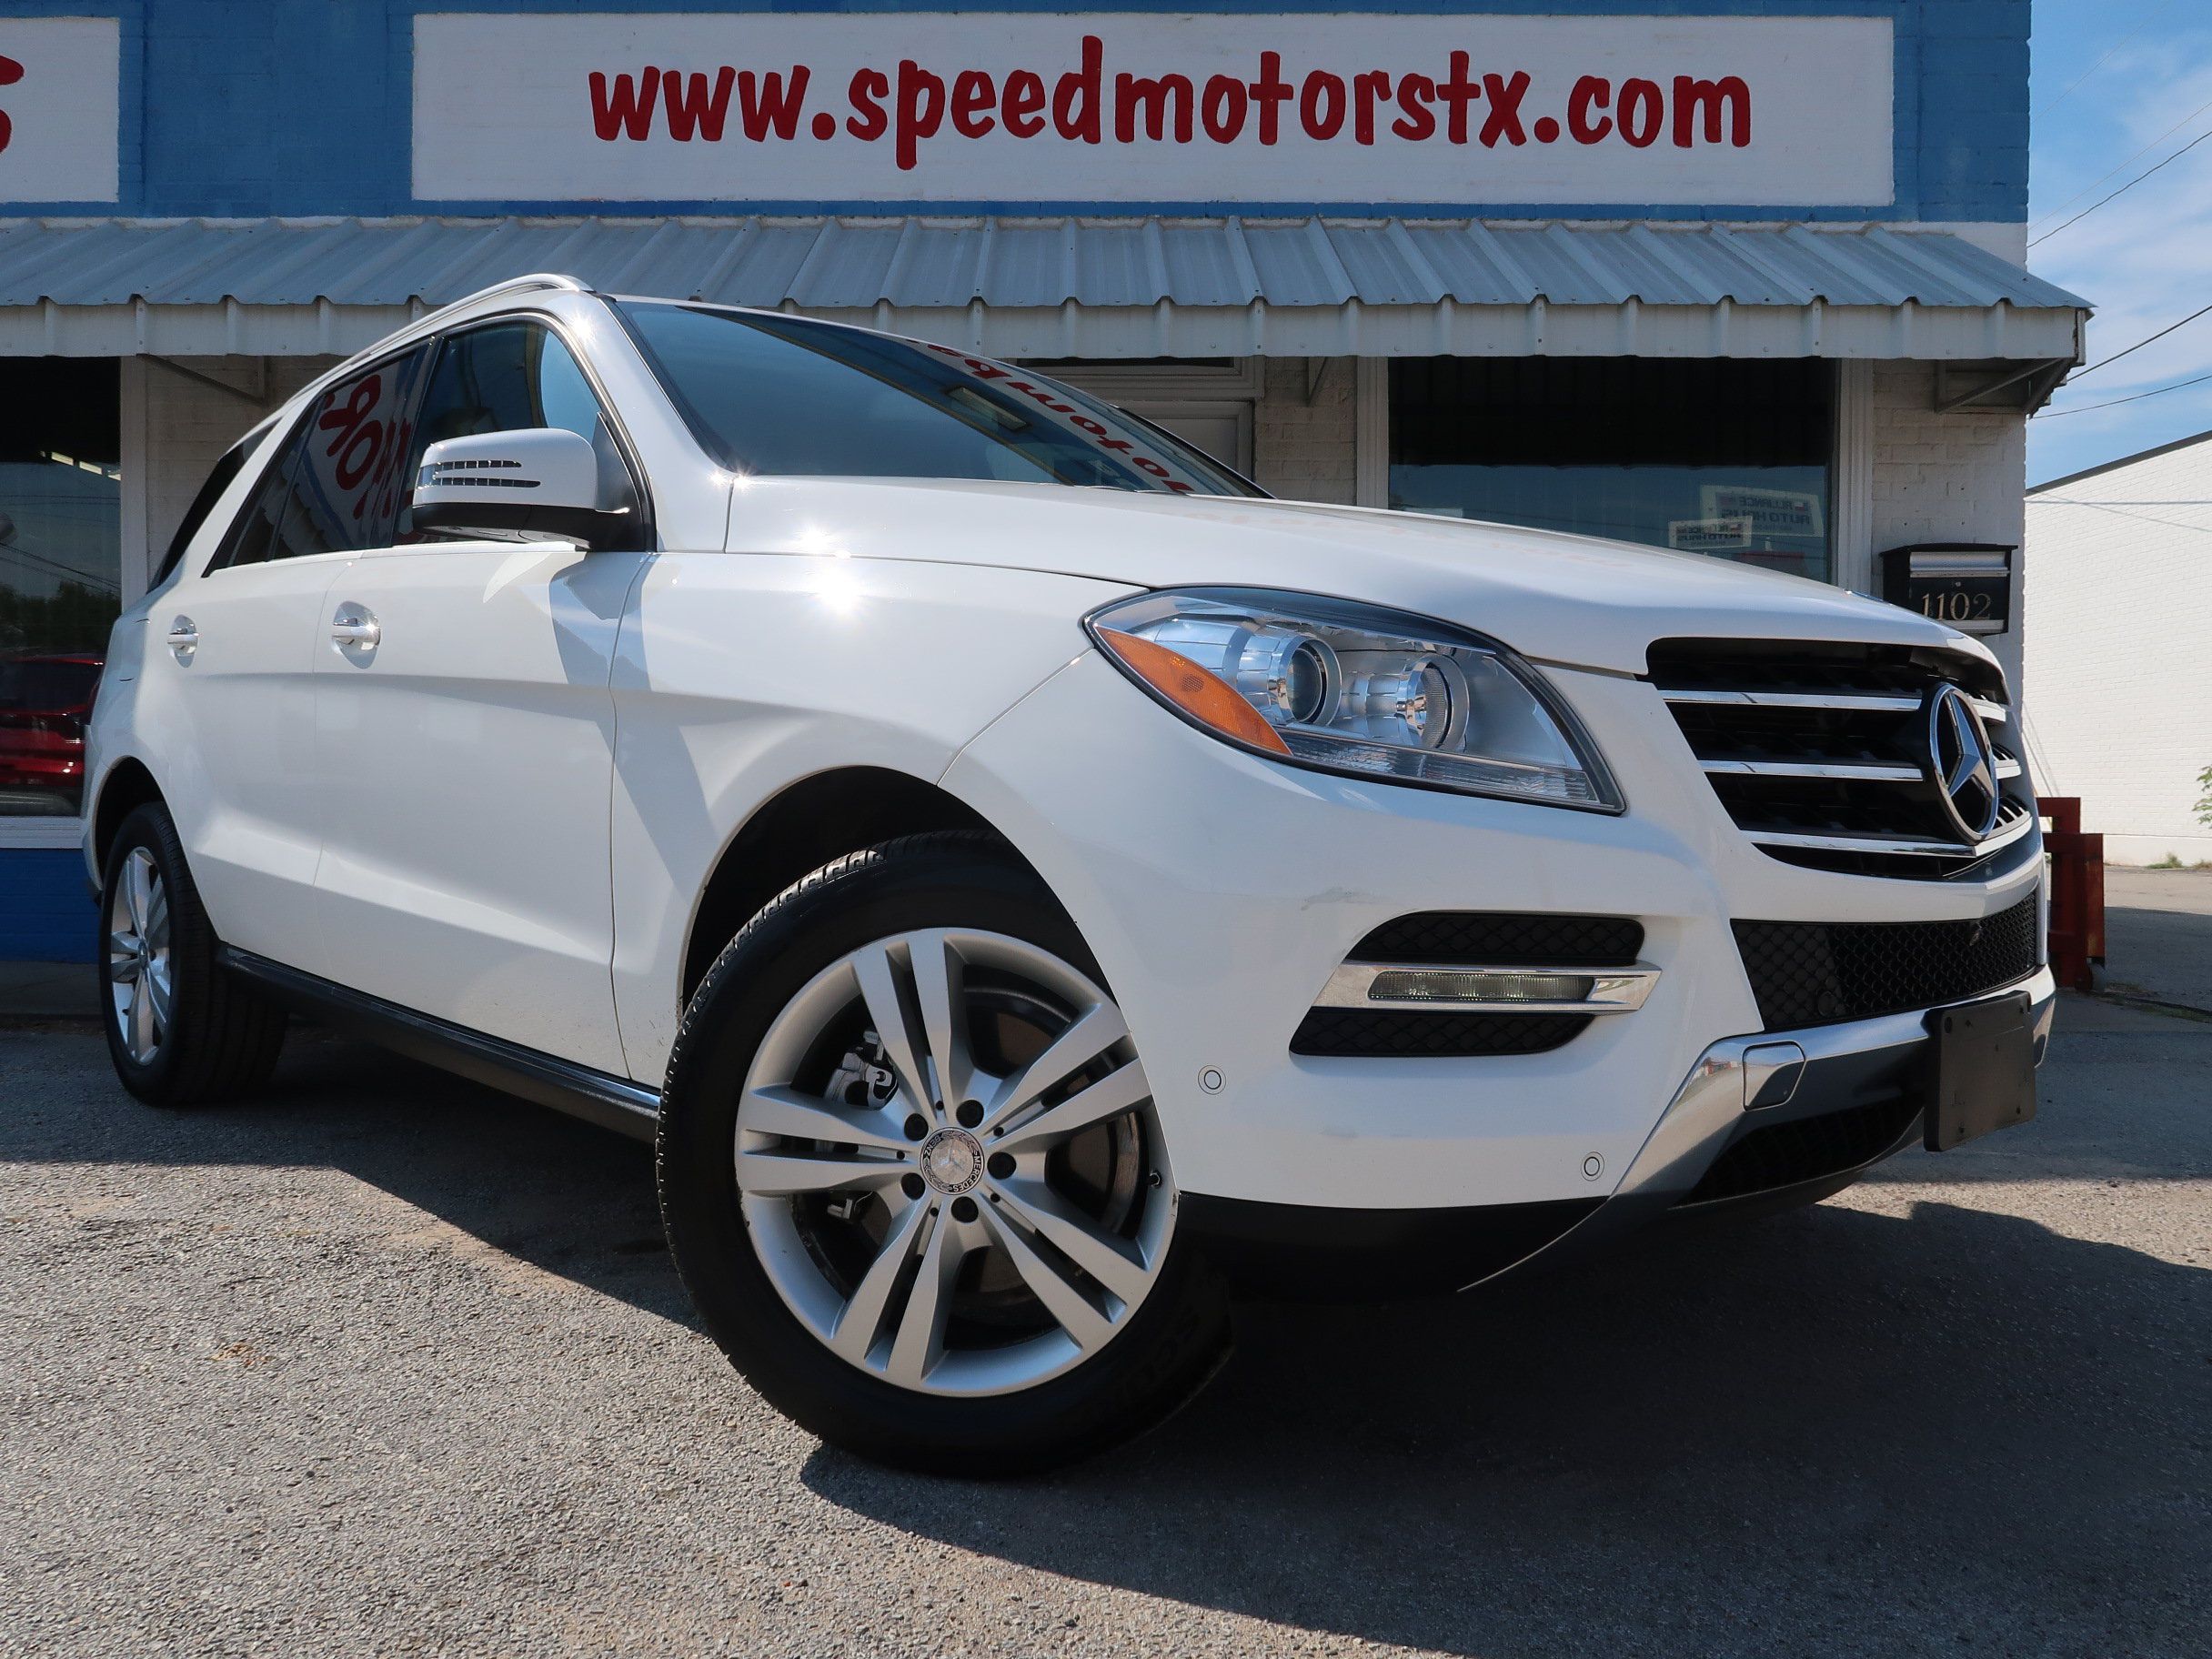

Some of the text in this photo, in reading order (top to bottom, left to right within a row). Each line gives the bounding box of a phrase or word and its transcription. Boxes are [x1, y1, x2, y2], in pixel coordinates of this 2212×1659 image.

[589, 35, 1750, 170] www.speedmotorstx.com
[1922, 592, 1991, 620] 1102
[923, 1135, 942, 1156] BENZ
[952, 1155, 982, 1192] MERCEDES
